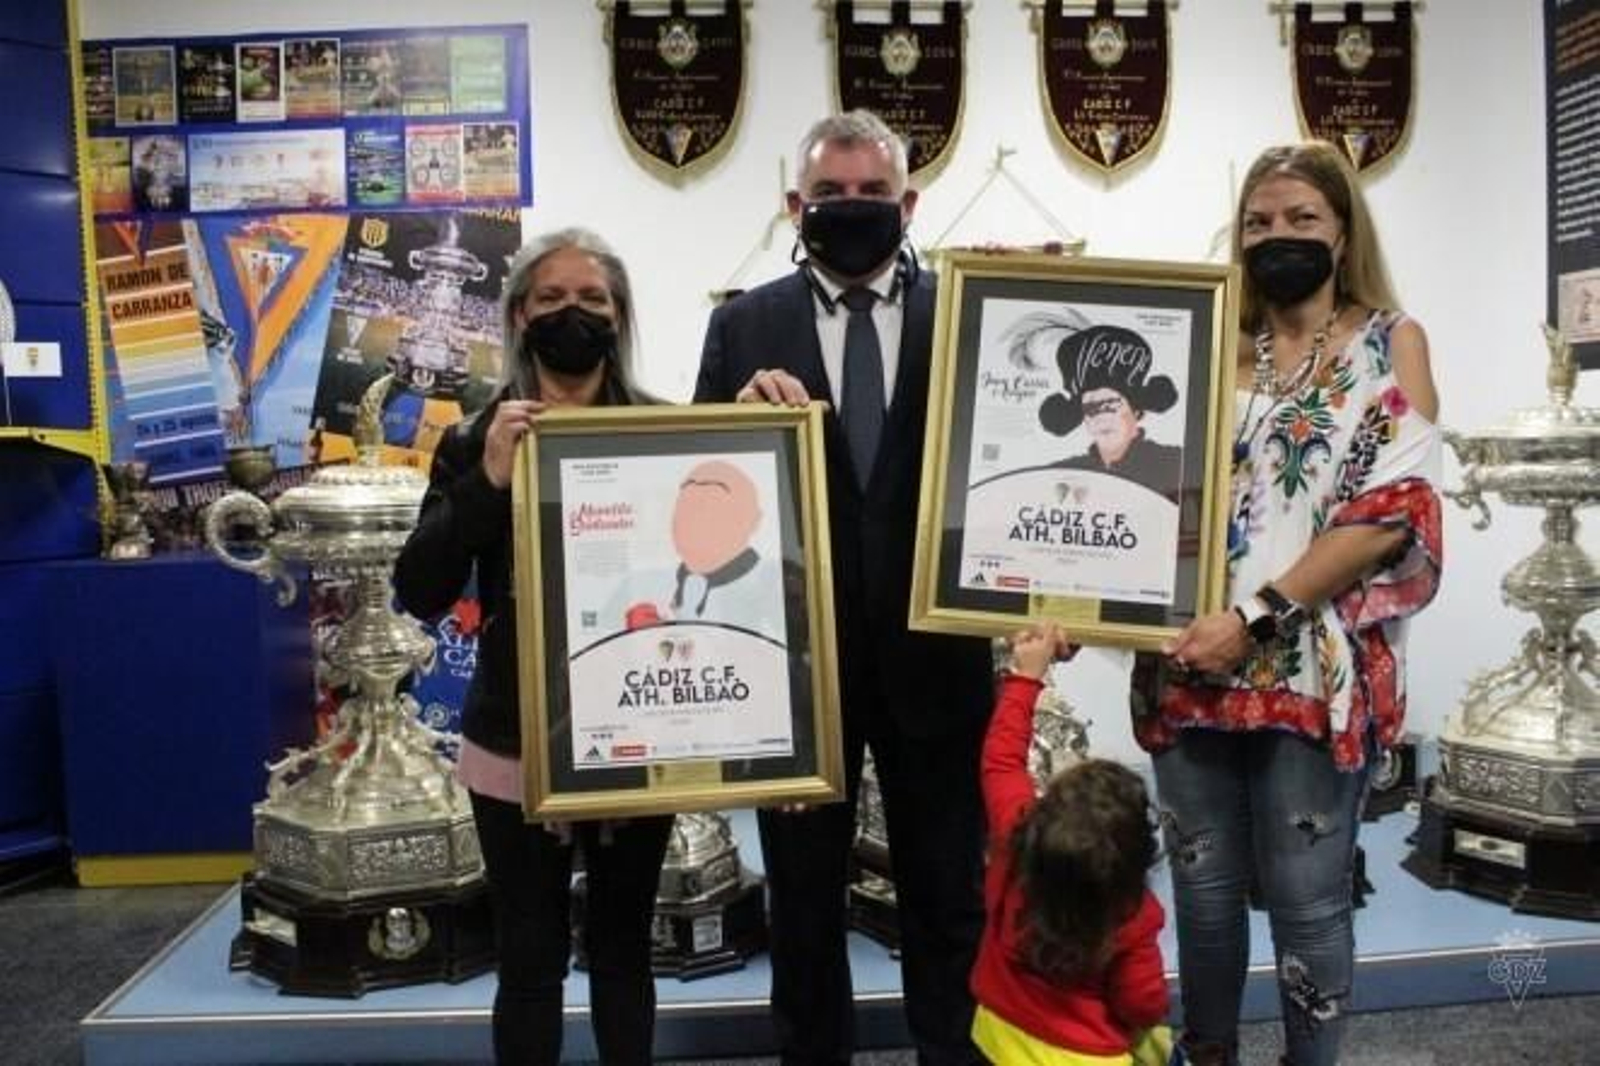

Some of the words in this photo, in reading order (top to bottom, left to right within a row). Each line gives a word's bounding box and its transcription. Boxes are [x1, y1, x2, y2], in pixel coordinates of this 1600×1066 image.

[106, 267, 162, 291] RAMON
[167, 263, 190, 280] DE
[111, 293, 193, 320] CARRANZA
[1018, 504, 1083, 527] CÁDIZ
[1091, 513, 1131, 532] C.F.
[1009, 524, 1055, 544] ATH.
[1062, 528, 1138, 550] BILBAO
[624, 664, 694, 688] CÁDIZ
[701, 666, 741, 684] C.F.
[617, 687, 667, 708] ATH.
[672, 682, 750, 704] BILBAO
